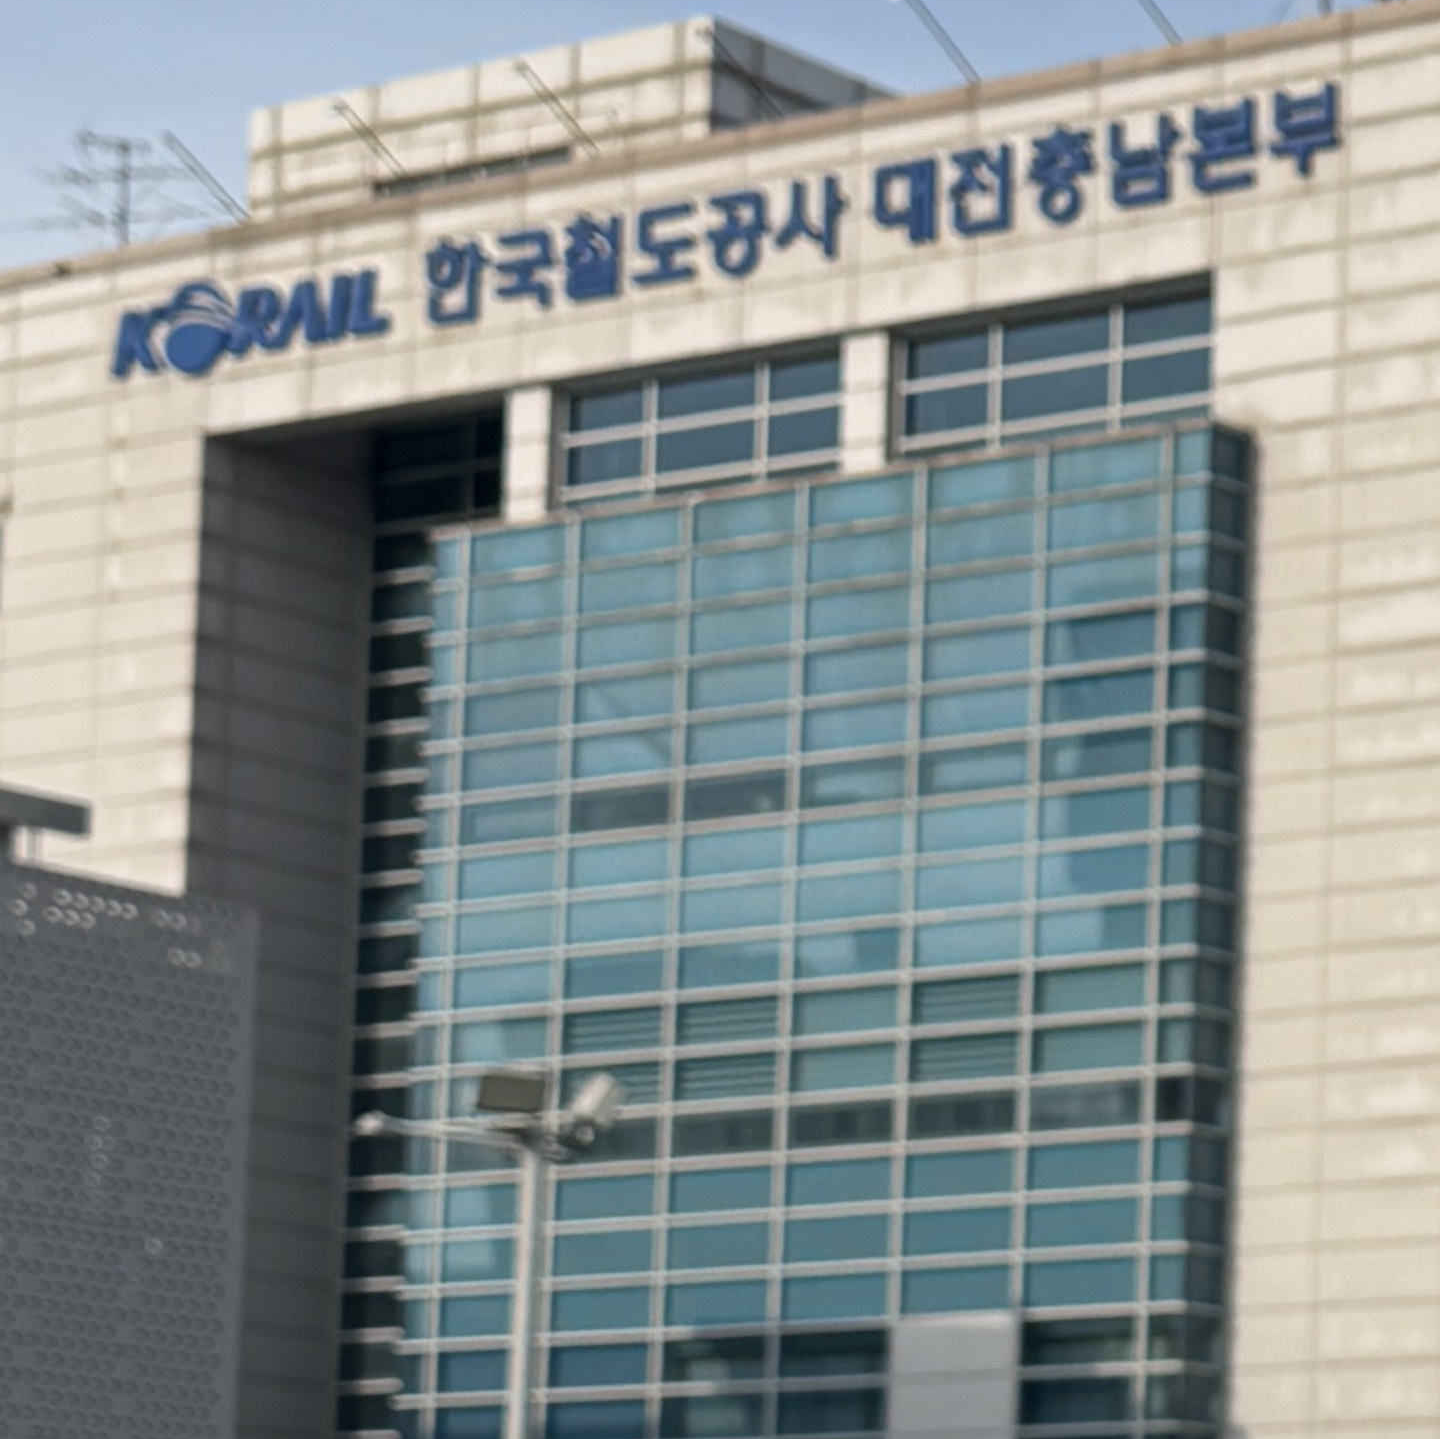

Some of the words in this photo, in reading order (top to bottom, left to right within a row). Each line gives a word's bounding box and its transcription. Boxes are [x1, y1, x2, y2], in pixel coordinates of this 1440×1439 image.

[424, 175, 844, 326] 한국철도공사
[870, 81, 1345, 247] 대전충남본부
[111, 268, 391, 381] KORAIL
